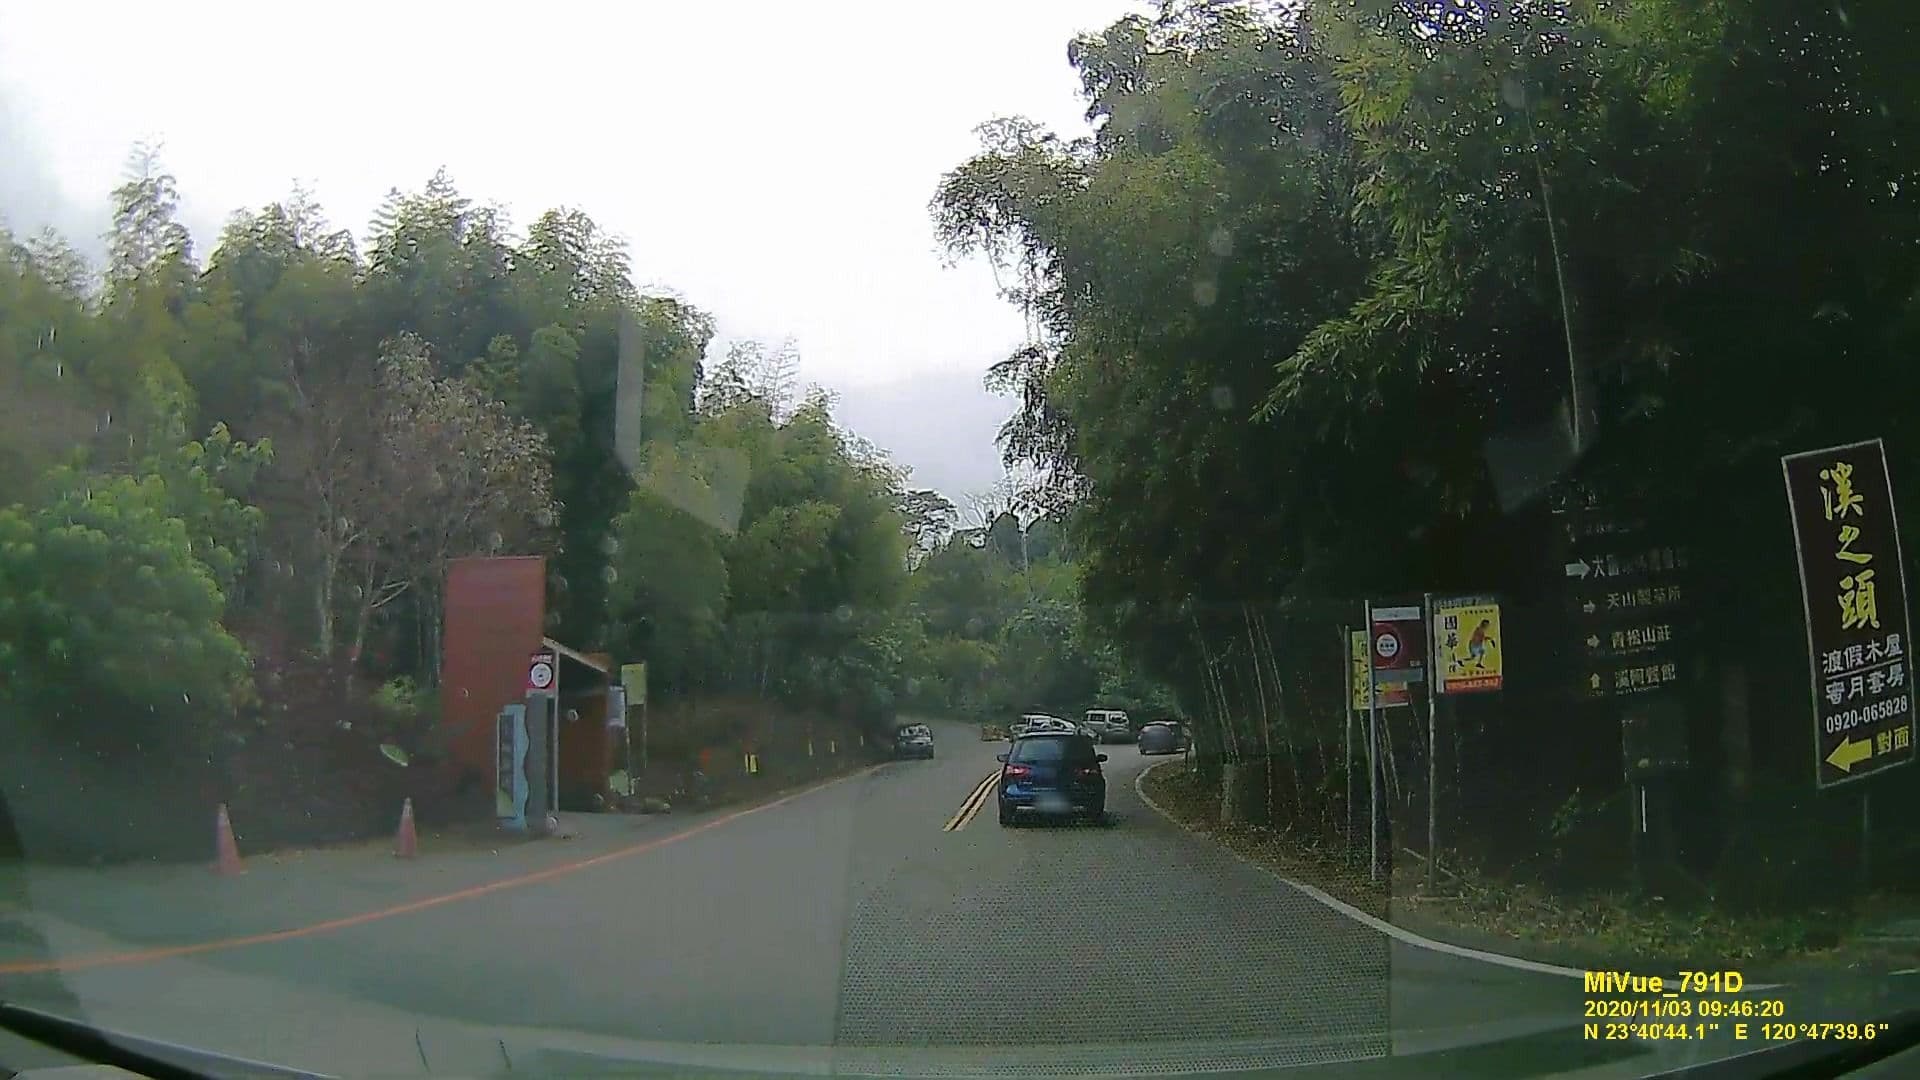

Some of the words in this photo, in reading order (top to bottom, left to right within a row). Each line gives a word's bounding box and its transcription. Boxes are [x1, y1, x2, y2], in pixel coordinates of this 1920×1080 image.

[1819, 462, 1881, 630] 溪之頭
[1822, 633, 1904, 673] 渡假木屋
[1825, 663, 1905, 705] 蜜月套房
[1826, 695, 1908, 734] 0920-065828
[1876, 725, 1910, 756] 對面
